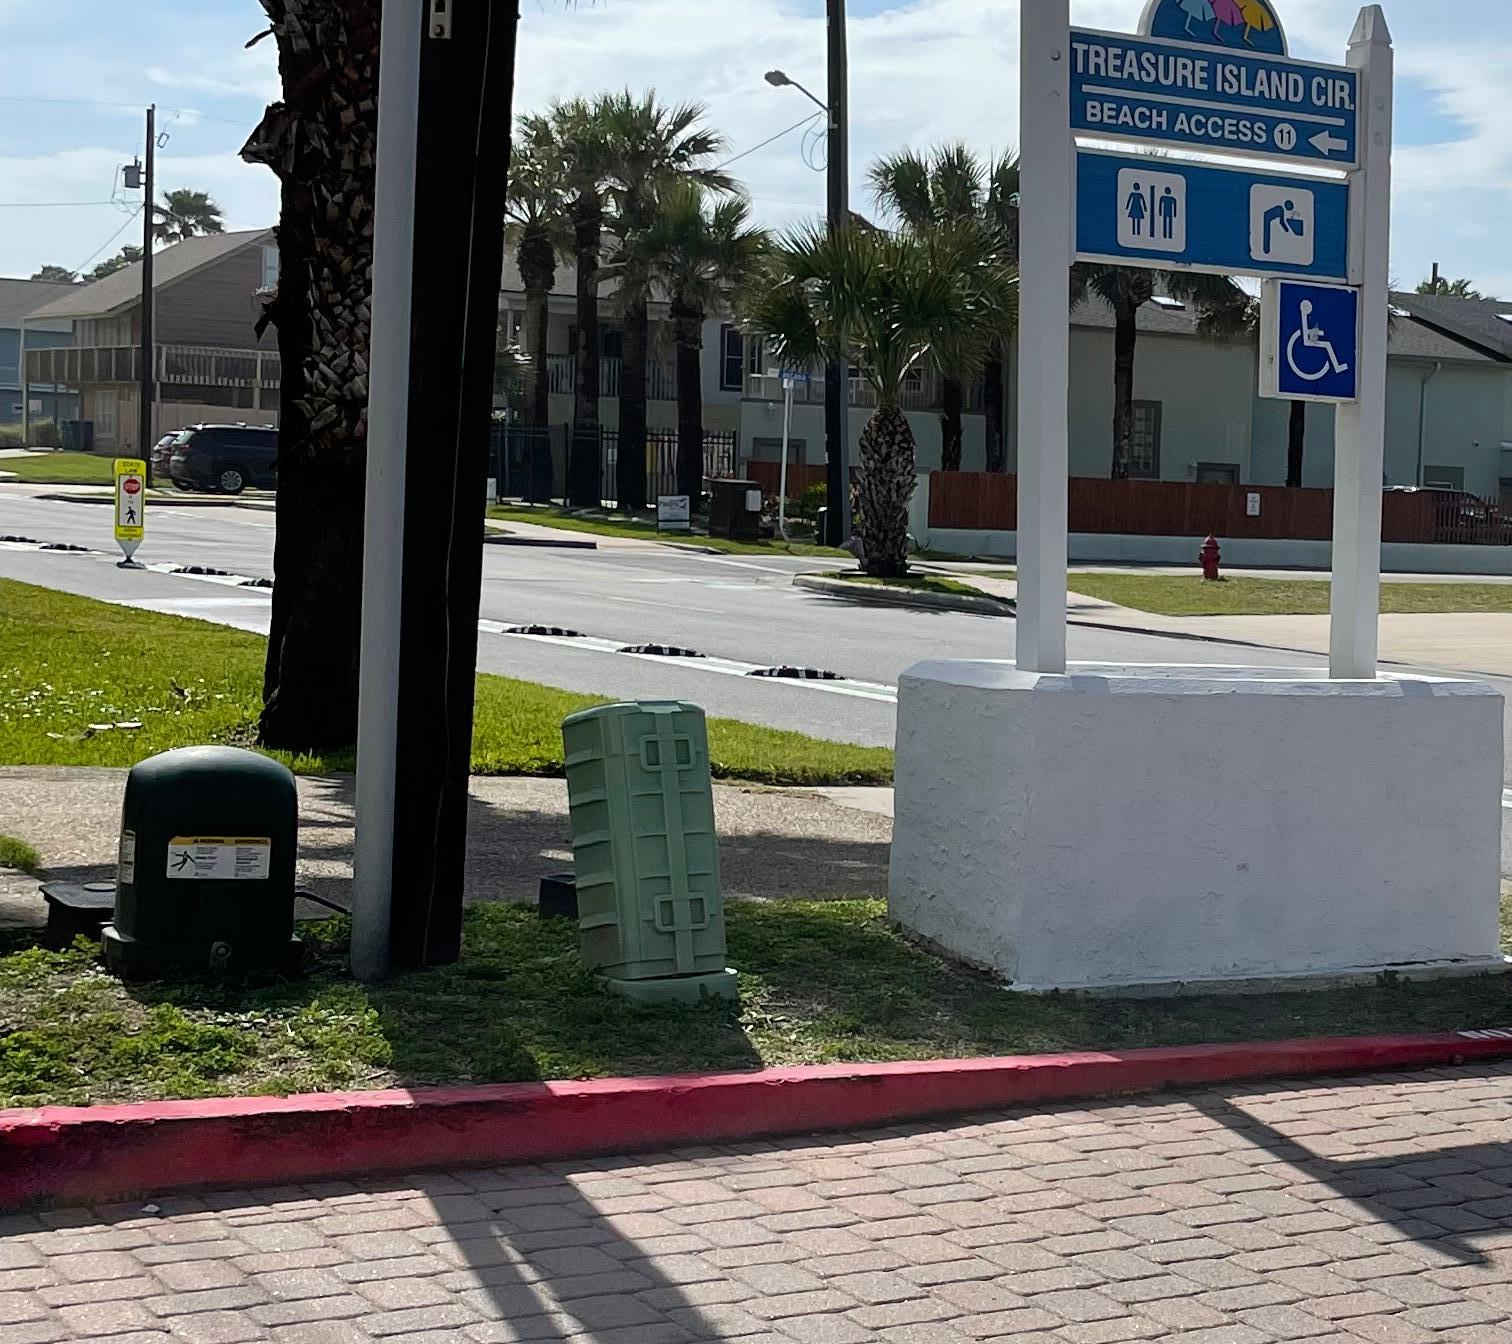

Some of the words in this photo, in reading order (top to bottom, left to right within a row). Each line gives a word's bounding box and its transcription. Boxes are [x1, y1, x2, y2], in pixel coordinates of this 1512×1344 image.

[1072, 42, 1209, 92] TREASURE
[1216, 63, 1304, 103] ISLAND
[1311, 76, 1355, 111] CIR.
[1086, 100, 1168, 131] BEACH
[1174, 112, 1267, 144] ACCESS
[1277, 127, 1293, 146] 11
